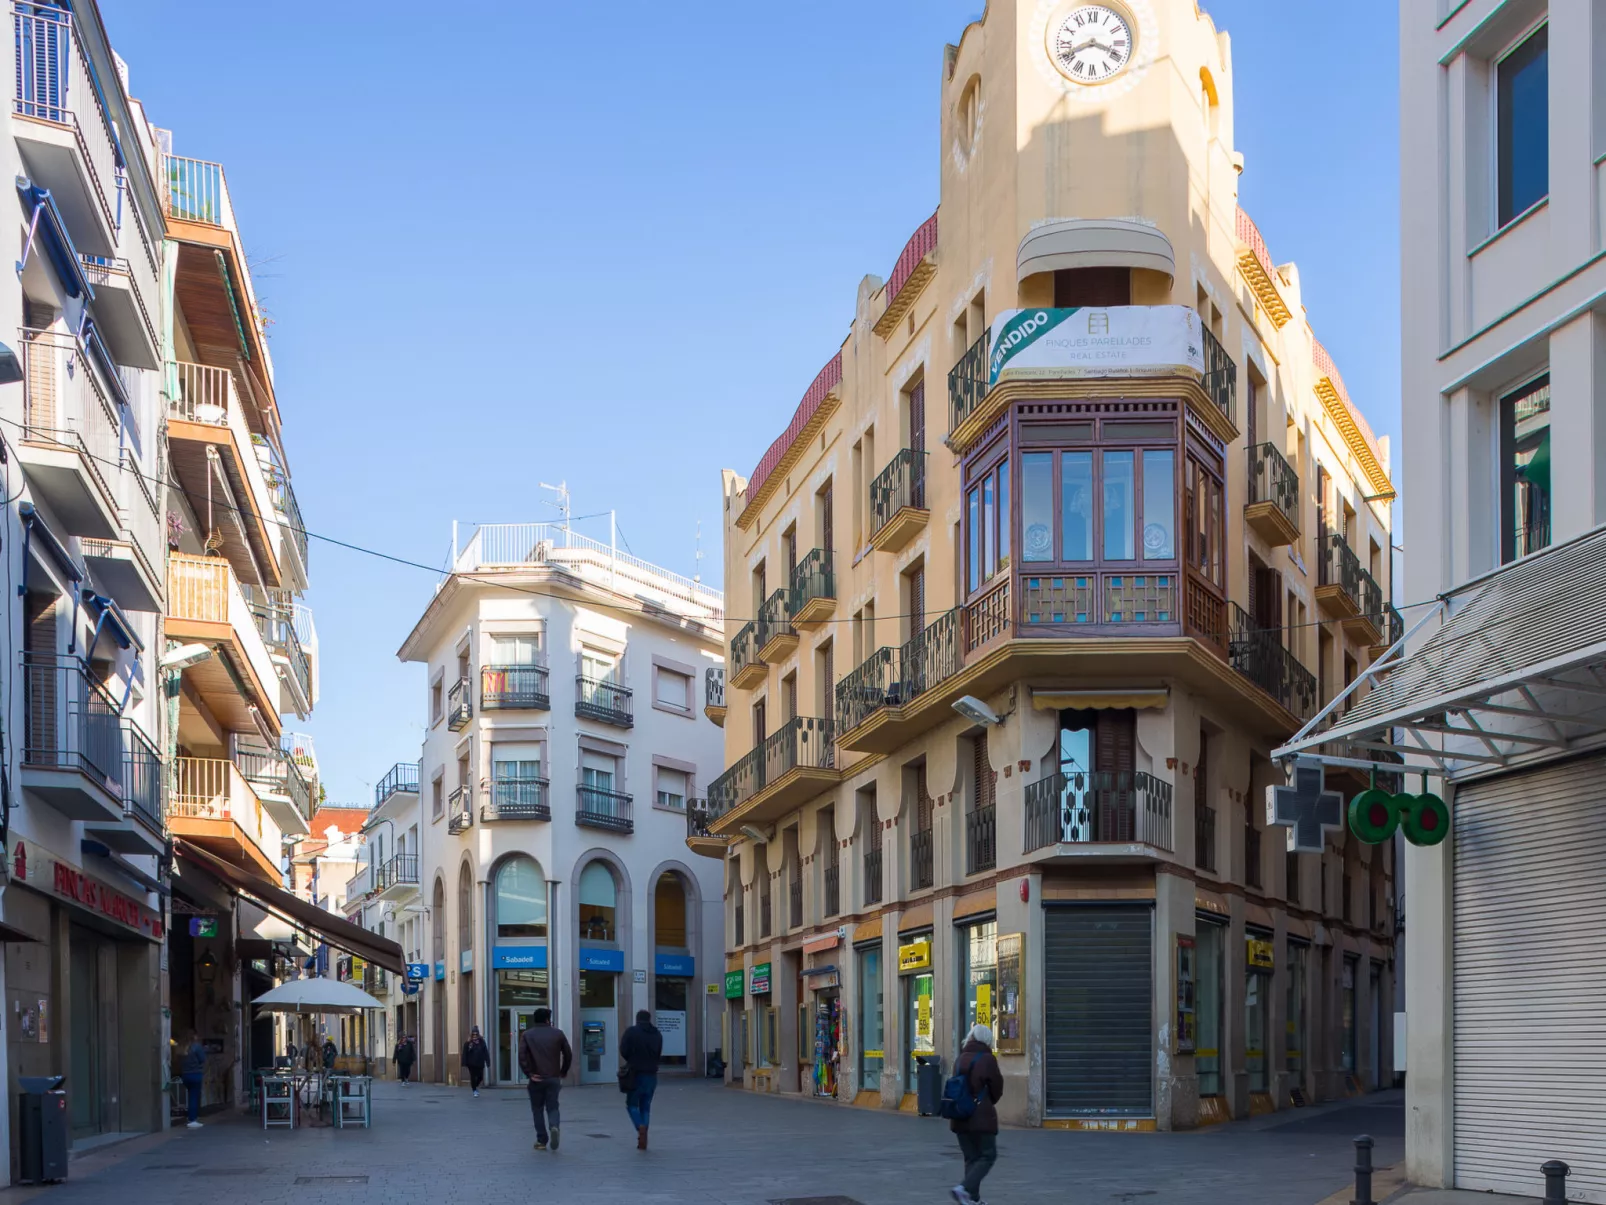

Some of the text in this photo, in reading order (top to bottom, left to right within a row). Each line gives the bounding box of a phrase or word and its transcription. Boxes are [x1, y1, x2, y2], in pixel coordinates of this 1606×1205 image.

[1074, 14, 1085, 28] XI
[1087, 11, 1098, 24] XII
[1102, 15, 1110, 26] I
[1064, 26, 1076, 36] X
[1110, 25, 1122, 34] II
[1060, 40, 1072, 48] IX
[1072, 60, 1084, 74] VII
[1088, 64, 1096, 76] VI
[1102, 61, 1111, 72] V
[992, 311, 1048, 374] VENDIDO
[1046, 336, 1152, 348] FINQUES PARELLADES
[1070, 350, 1127, 361] REAL ESTATE
[54, 861, 96, 909] FINCAS
[412, 966, 421, 977] S
